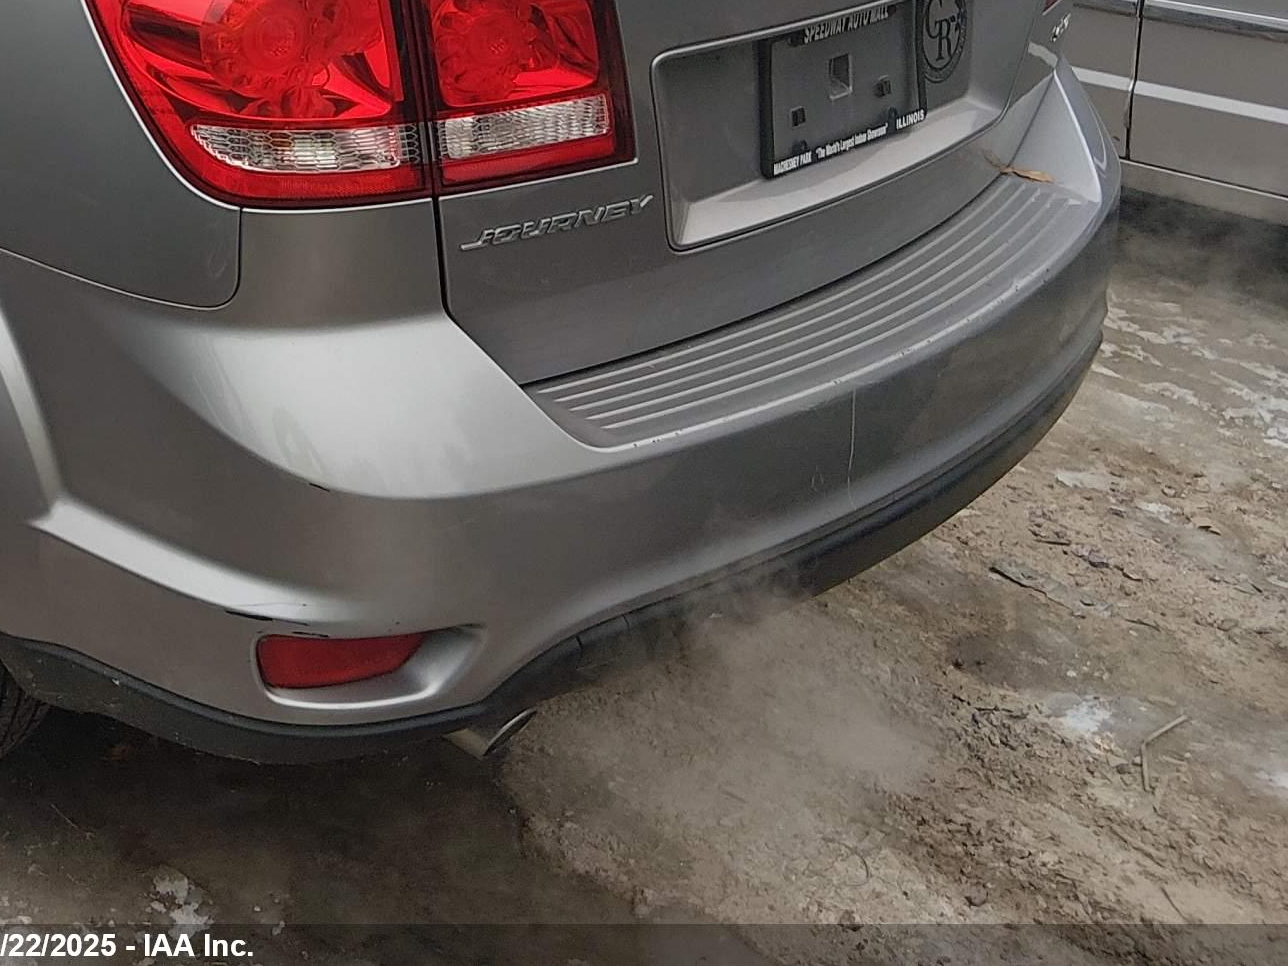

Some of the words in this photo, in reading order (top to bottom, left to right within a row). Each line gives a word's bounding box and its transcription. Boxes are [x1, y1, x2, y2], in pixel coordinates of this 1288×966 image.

[804, 17, 846, 44] SPEEDWAY
[847, 9, 872, 31] AUTO
[871, 4, 889, 24] MALL
[800, 150, 812, 165] PARK
[896, 108, 925, 131] ILLINOIS
[460, 194, 654, 250] JOURNEY
